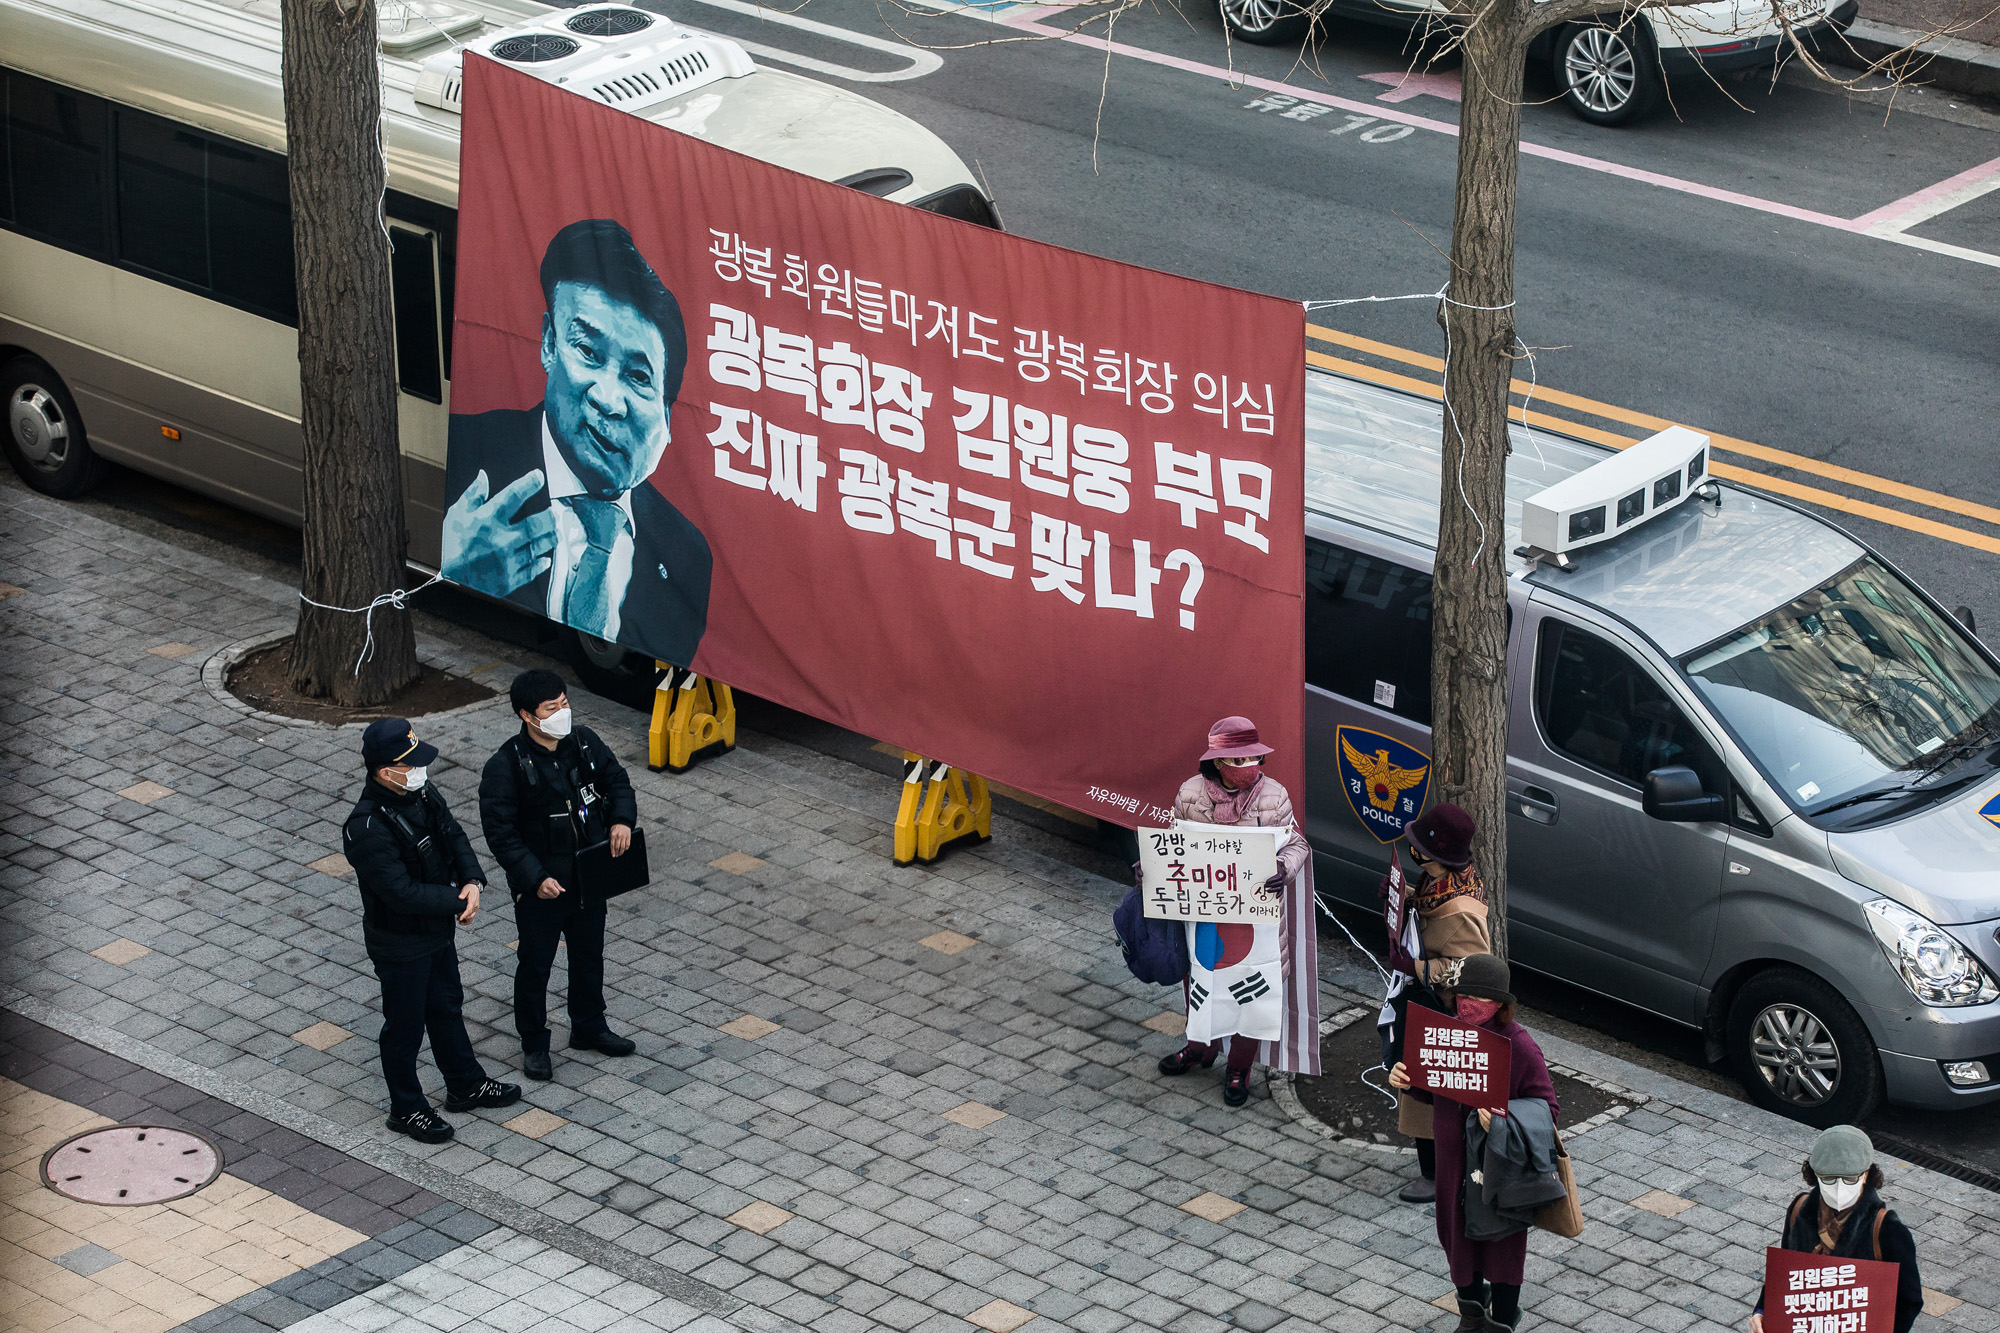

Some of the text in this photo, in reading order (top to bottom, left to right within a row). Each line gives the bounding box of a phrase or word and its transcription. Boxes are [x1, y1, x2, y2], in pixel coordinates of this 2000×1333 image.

[1328, 115, 1415, 143] 10
[1013, 325, 1177, 414] 광복회장
[1193, 372, 1274, 435] 의심
[706, 302, 1273, 554] 광복회장 김원웅 부모
[705, 401, 1205, 631] 진짜 광복군 맞나?
[1086, 785, 1140, 813] 자유의바람
[1149, 806, 1174, 823] 자유
[1350, 778, 1414, 813] 경 찰
[1362, 805, 1402, 828] POLICE
[1205, 838, 1242, 854] 가야할
[1424, 1027, 1478, 1048] 김원웅은
[1420, 1048, 1488, 1070] 떳떳하다면
[1427, 1069, 1487, 1092] 공개하라!
[1788, 1264, 1856, 1291] 김원웅은
[1784, 1286, 1869, 1315] 떳떳하다면
[1792, 1311, 1867, 1333] 공개하라!
